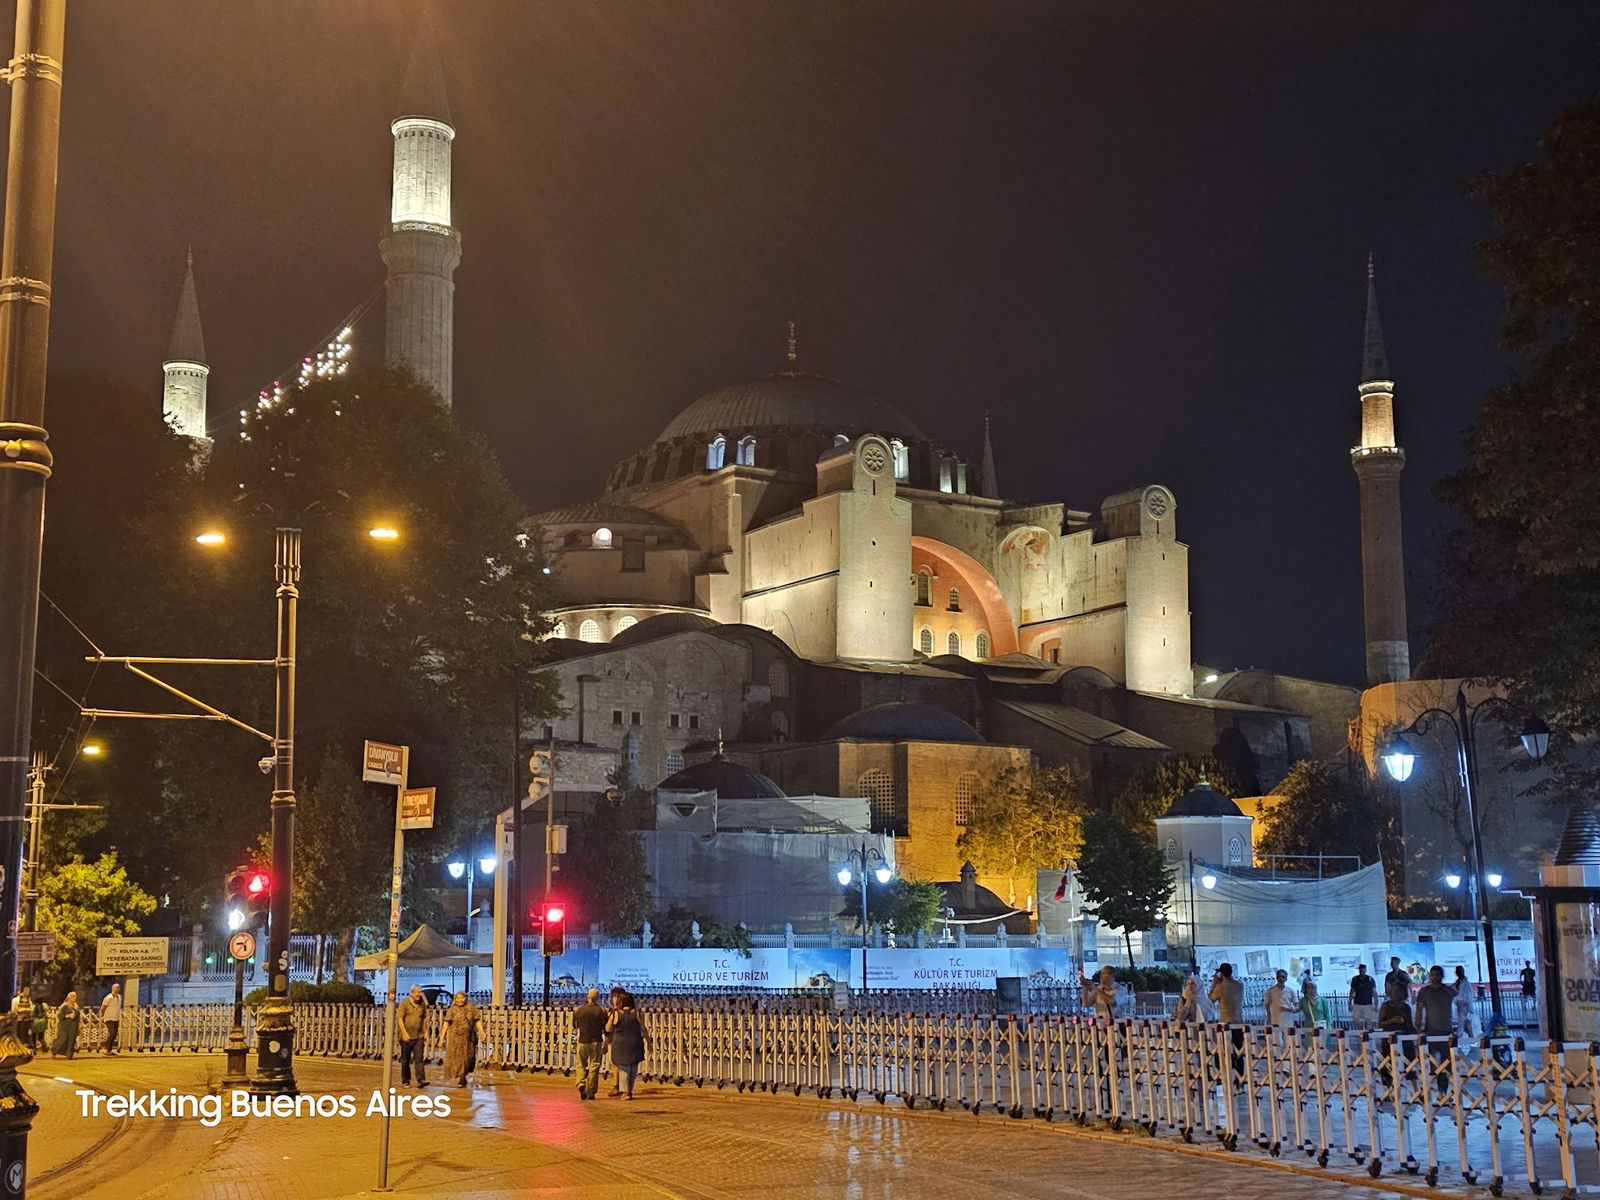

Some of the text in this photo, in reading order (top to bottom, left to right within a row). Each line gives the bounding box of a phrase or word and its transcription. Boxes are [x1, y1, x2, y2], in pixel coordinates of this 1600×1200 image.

[369, 746, 399, 762] DİVANYOLU
[713, 959, 731, 969] T.C.
[948, 958, 965, 967] T.C.
[1496, 957, 1513, 966] LTÜR
[1513, 957, 1522, 966] VE
[672, 969, 769, 982] KÜLTÜR VE TURİZM
[914, 967, 949, 979] KÜLTÜR
[951, 969, 963, 979] VE
[965, 967, 998, 979] TURİZM
[932, 979, 981, 990] BAKANLIĞI
[1565, 979, 1600, 990] DAVI
[1567, 990, 1600, 1002] GUE
